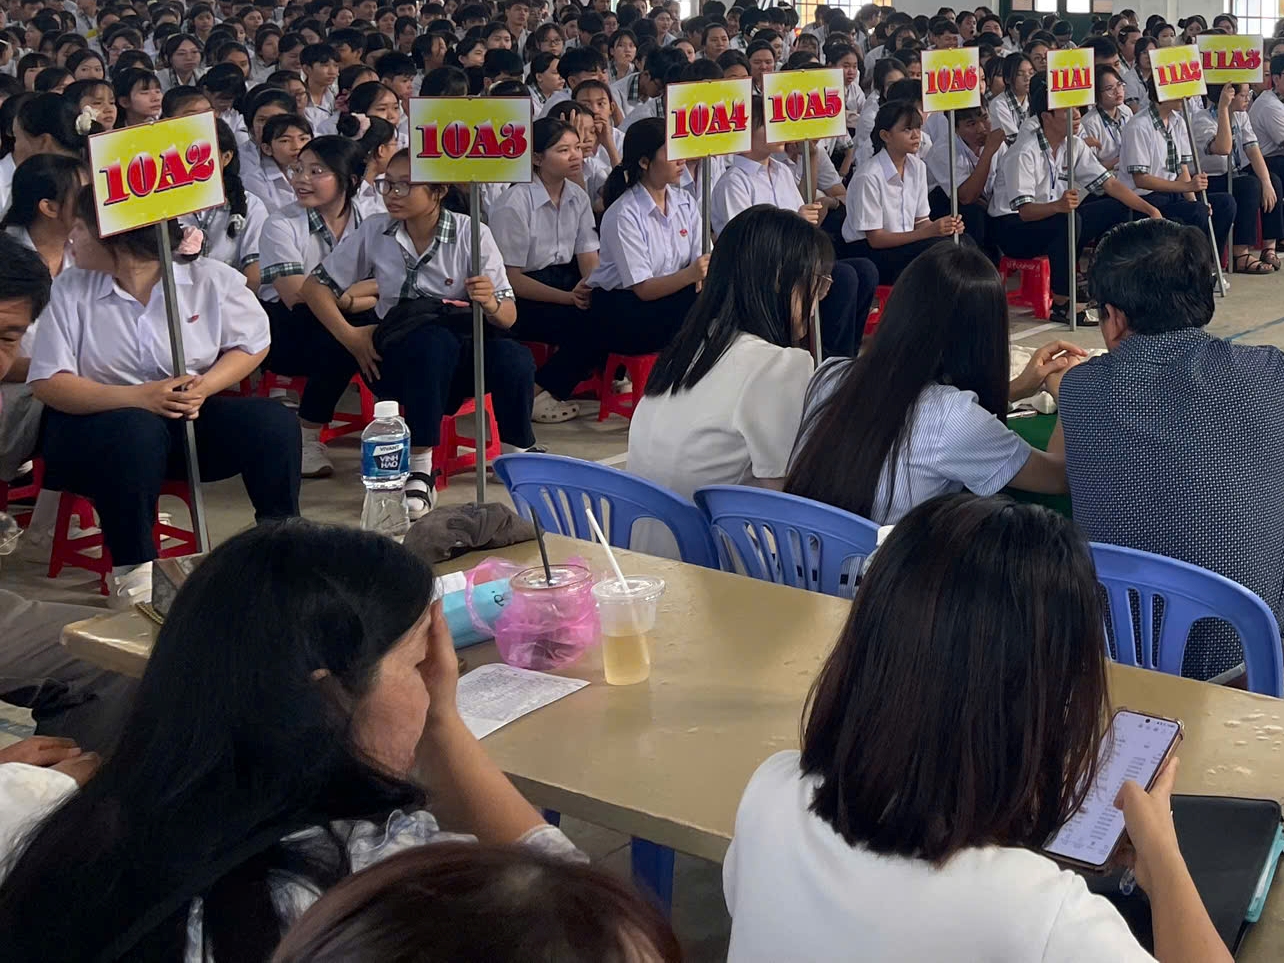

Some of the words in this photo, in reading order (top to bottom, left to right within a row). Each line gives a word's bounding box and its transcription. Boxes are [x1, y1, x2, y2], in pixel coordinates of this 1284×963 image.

[1155, 61, 1202, 86] 11A2
[1200, 48, 1262, 70] 11A3
[925, 65, 978, 94] 10A6
[1050, 64, 1092, 92] 11A1
[671, 97, 749, 138] 10A4
[768, 87, 842, 123] 10A5
[415, 119, 528, 159] 10A3
[99, 139, 215, 206] 10A2
